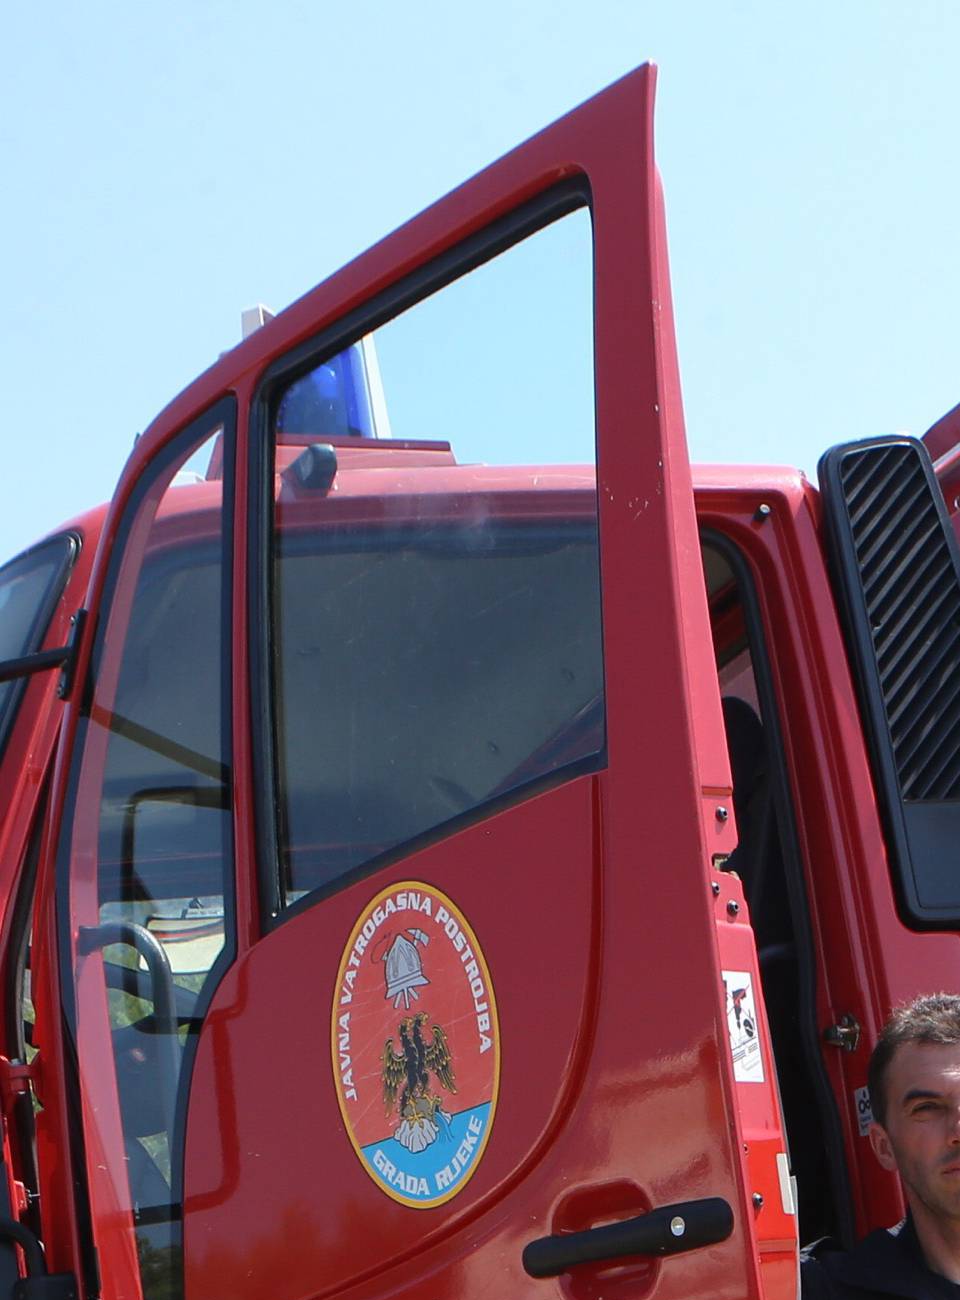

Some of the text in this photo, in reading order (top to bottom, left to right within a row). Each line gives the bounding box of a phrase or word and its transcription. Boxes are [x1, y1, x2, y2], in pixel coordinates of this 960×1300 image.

[337, 891, 492, 1101] JAVNA VATROGASNA POSTROJBA
[371, 1113, 484, 1196] GRADA RIJEKE
